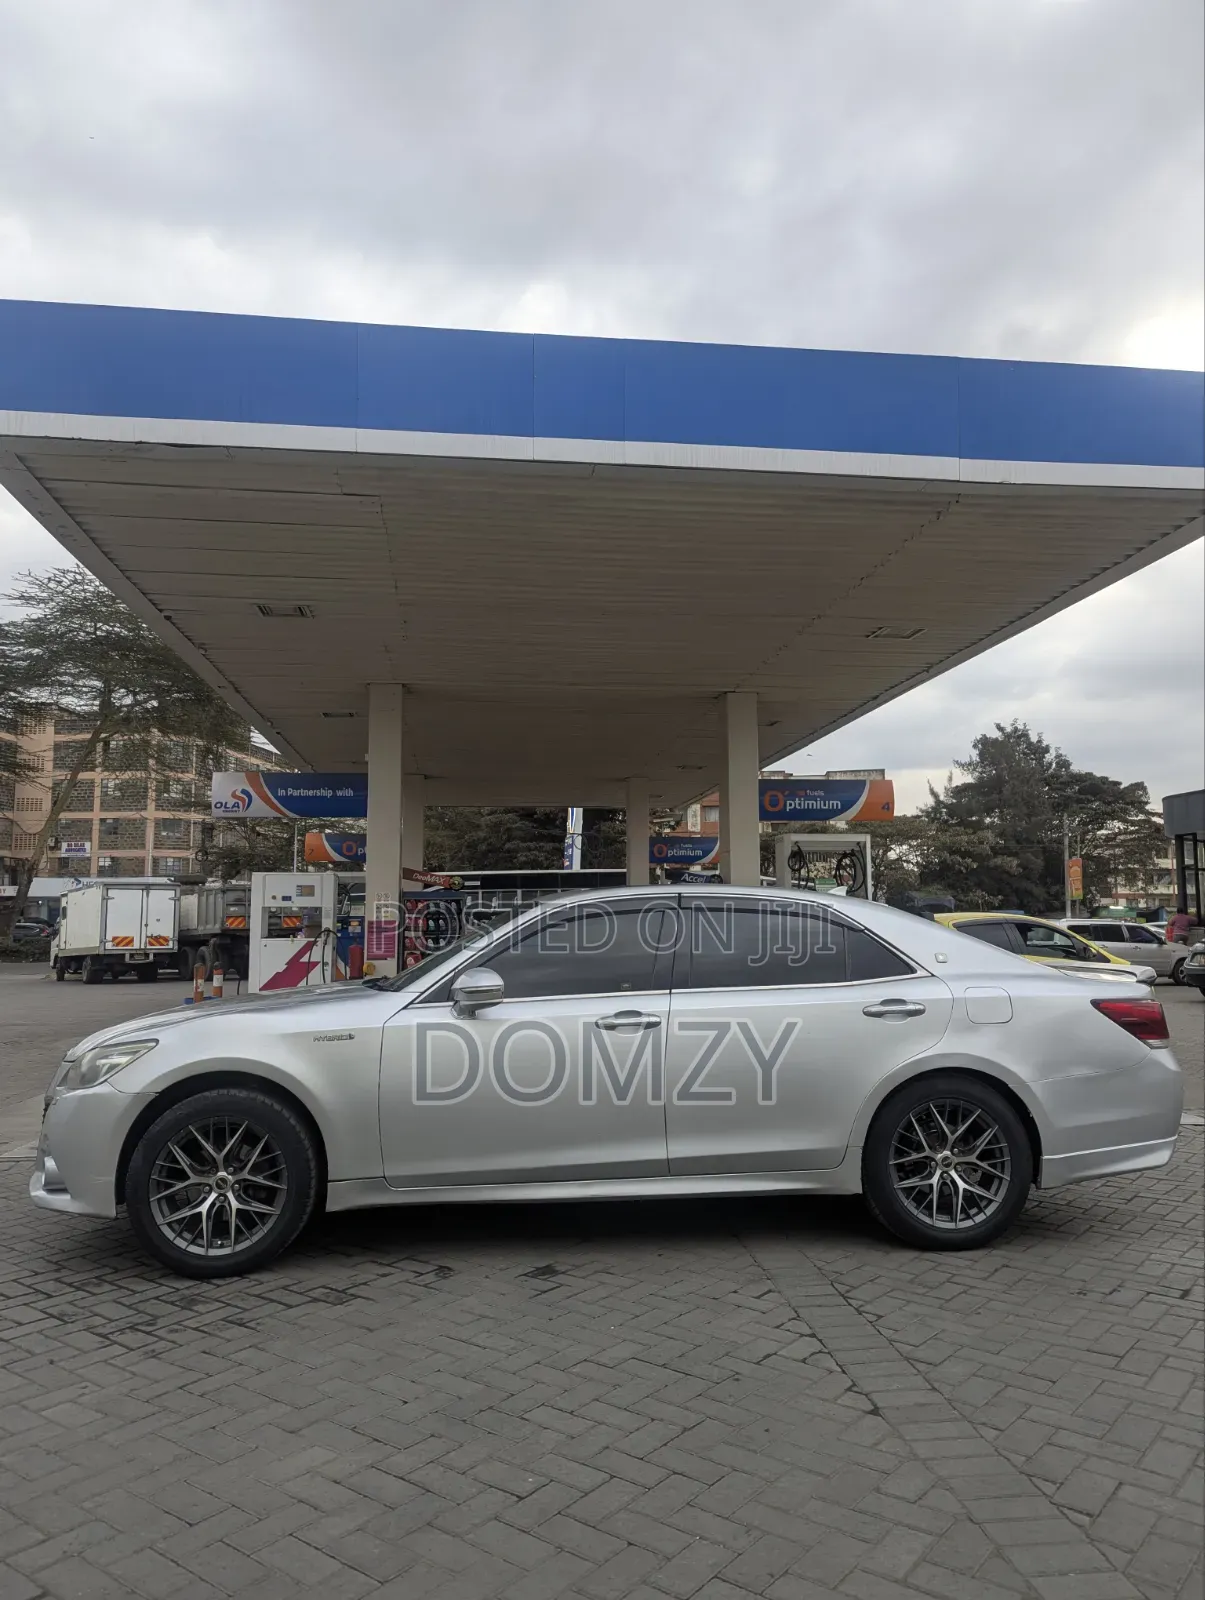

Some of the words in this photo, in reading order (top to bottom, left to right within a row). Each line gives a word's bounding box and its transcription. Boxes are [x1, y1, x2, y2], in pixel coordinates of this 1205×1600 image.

[278, 788, 286, 797] In
[287, 787, 333, 798] Partnership
[336, 788, 354, 797] with
[806, 789, 825, 797] fuels
[214, 801, 241, 810] OLA
[881, 801, 892, 812] 4
[680, 872, 707, 884] Accel
